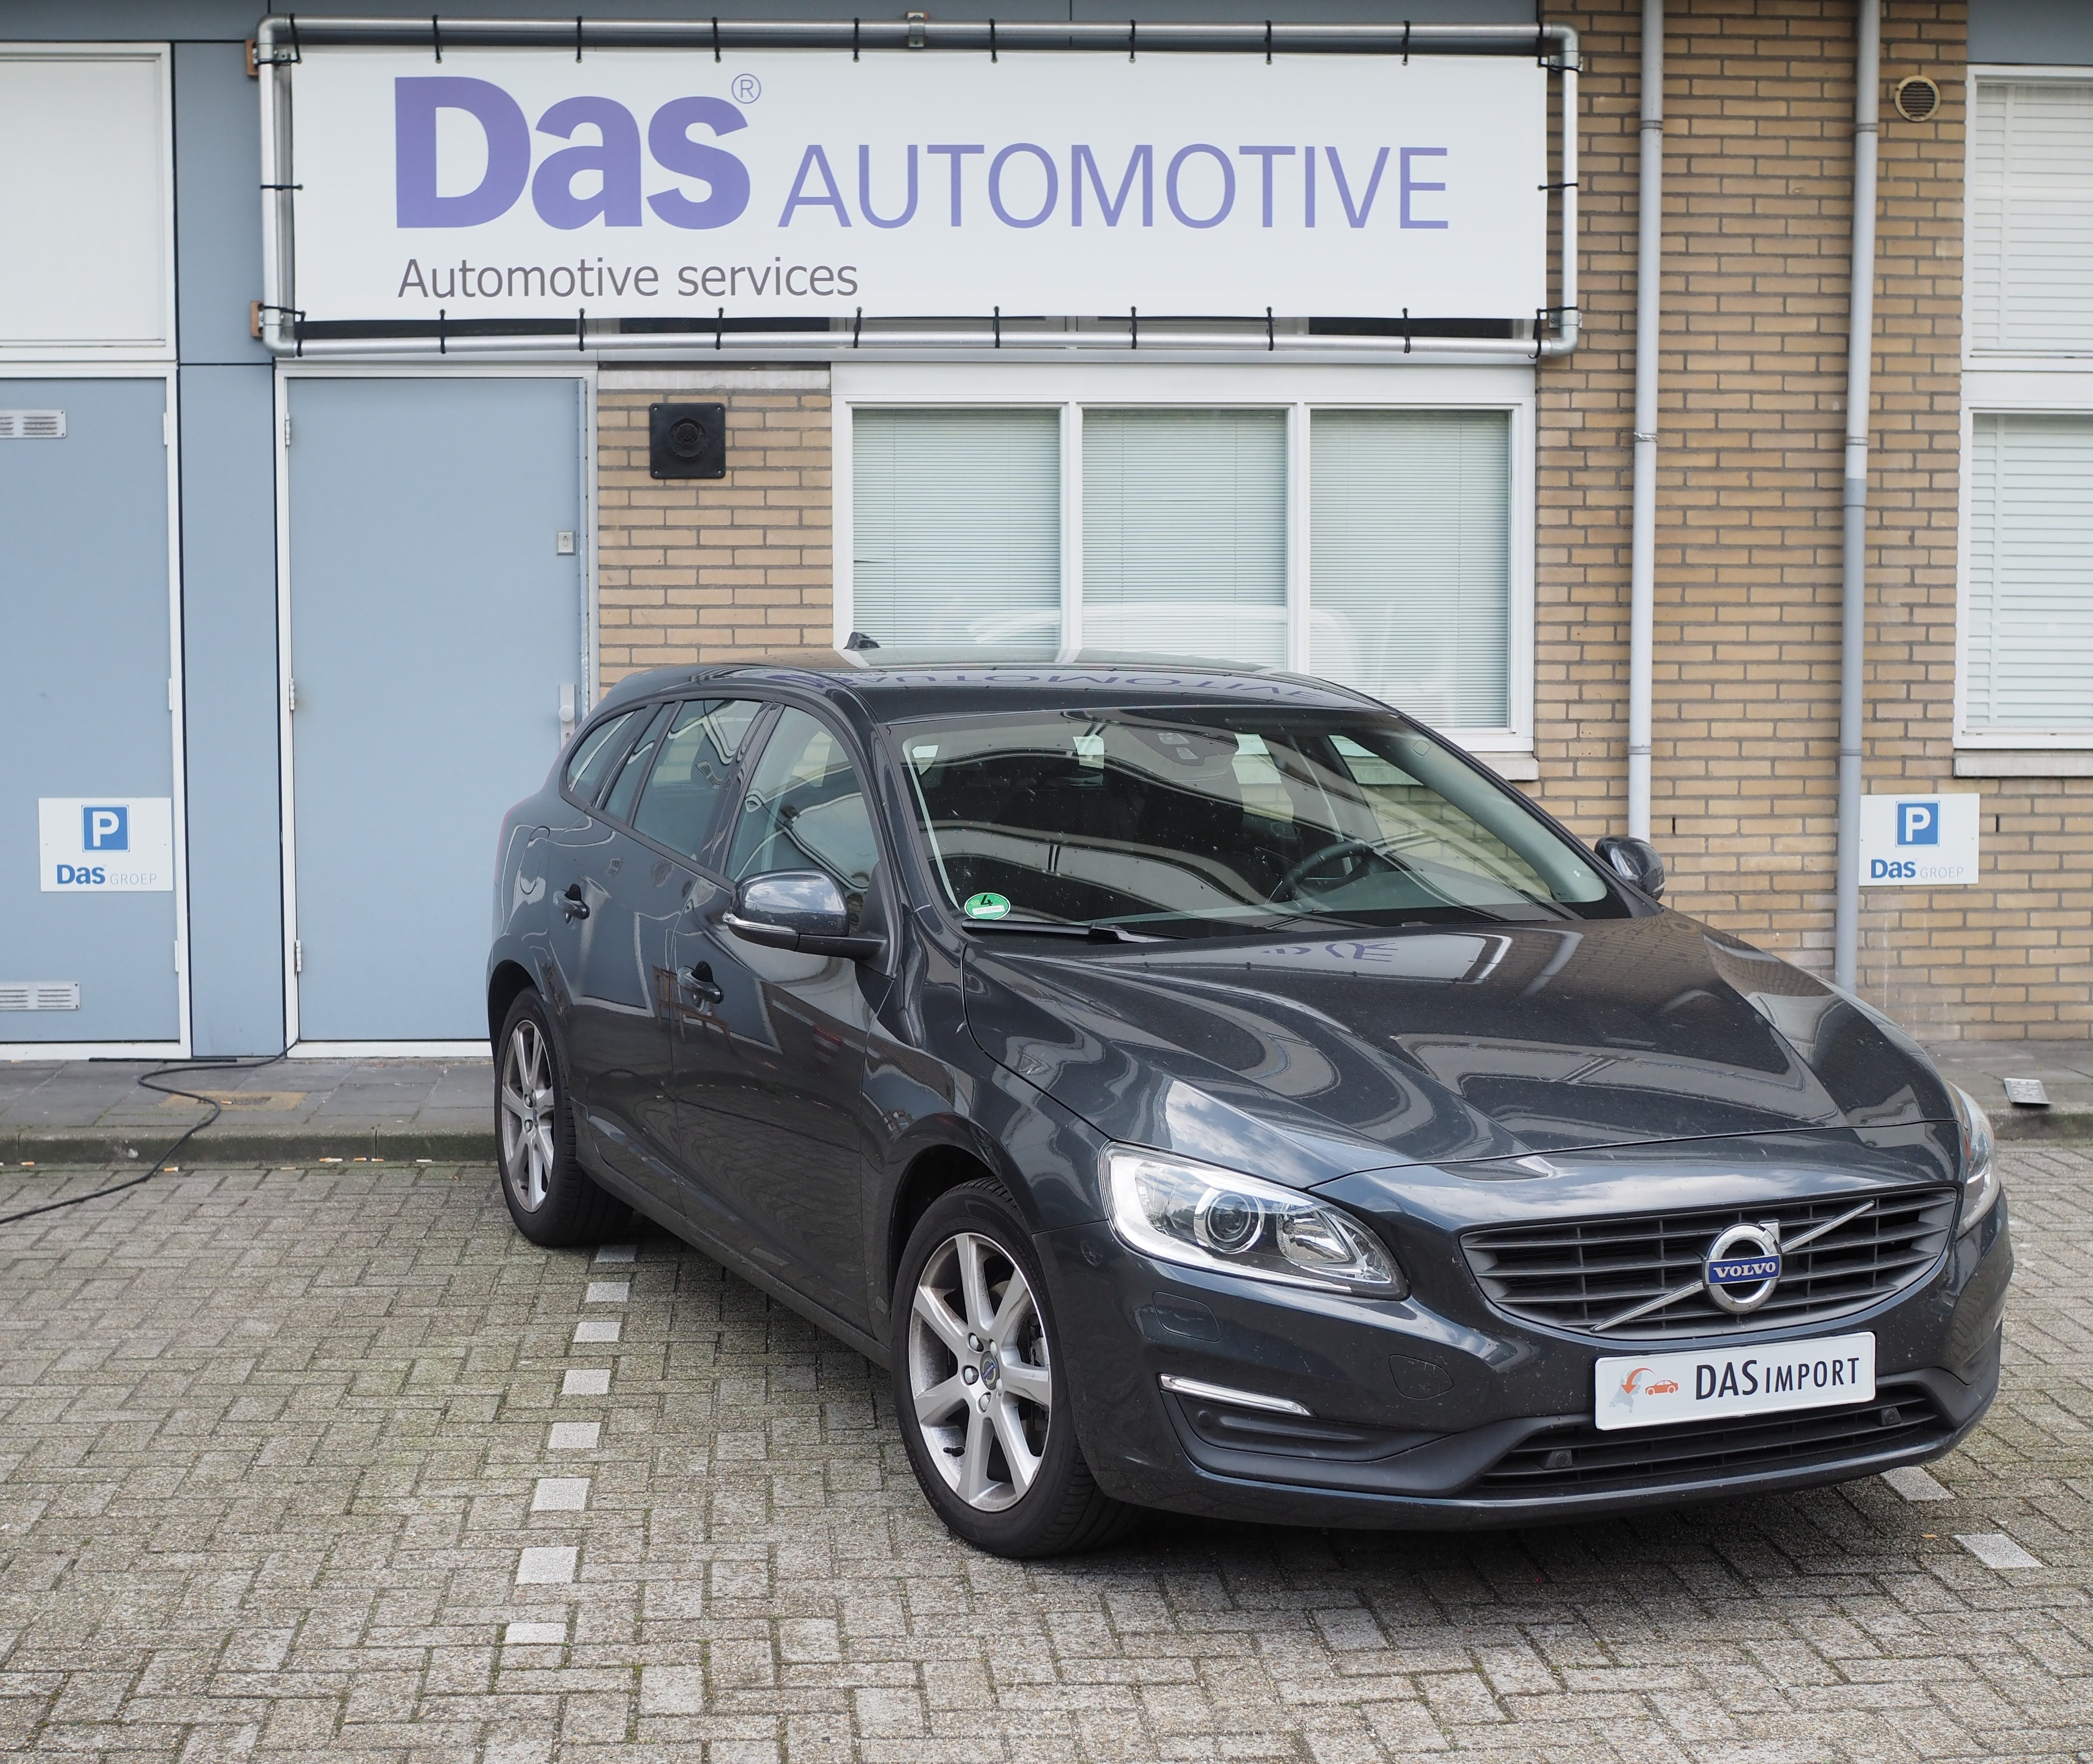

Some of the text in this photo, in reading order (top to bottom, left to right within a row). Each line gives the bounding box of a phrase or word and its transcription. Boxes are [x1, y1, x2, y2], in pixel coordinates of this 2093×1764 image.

[778, 143, 1449, 229] AUTOMOTIVE
[398, 257, 858, 298] Automotive services
[92, 811, 119, 847] P
[1905, 807, 1931, 842] P
[57, 864, 157, 886] Das GROEP
[1870, 859, 1964, 878] Das GROEP
[980, 895, 993, 905] 4
[1713, 1262, 1776, 1278] VOLVO
[1695, 1357, 1859, 1400] DAS IMPORT
